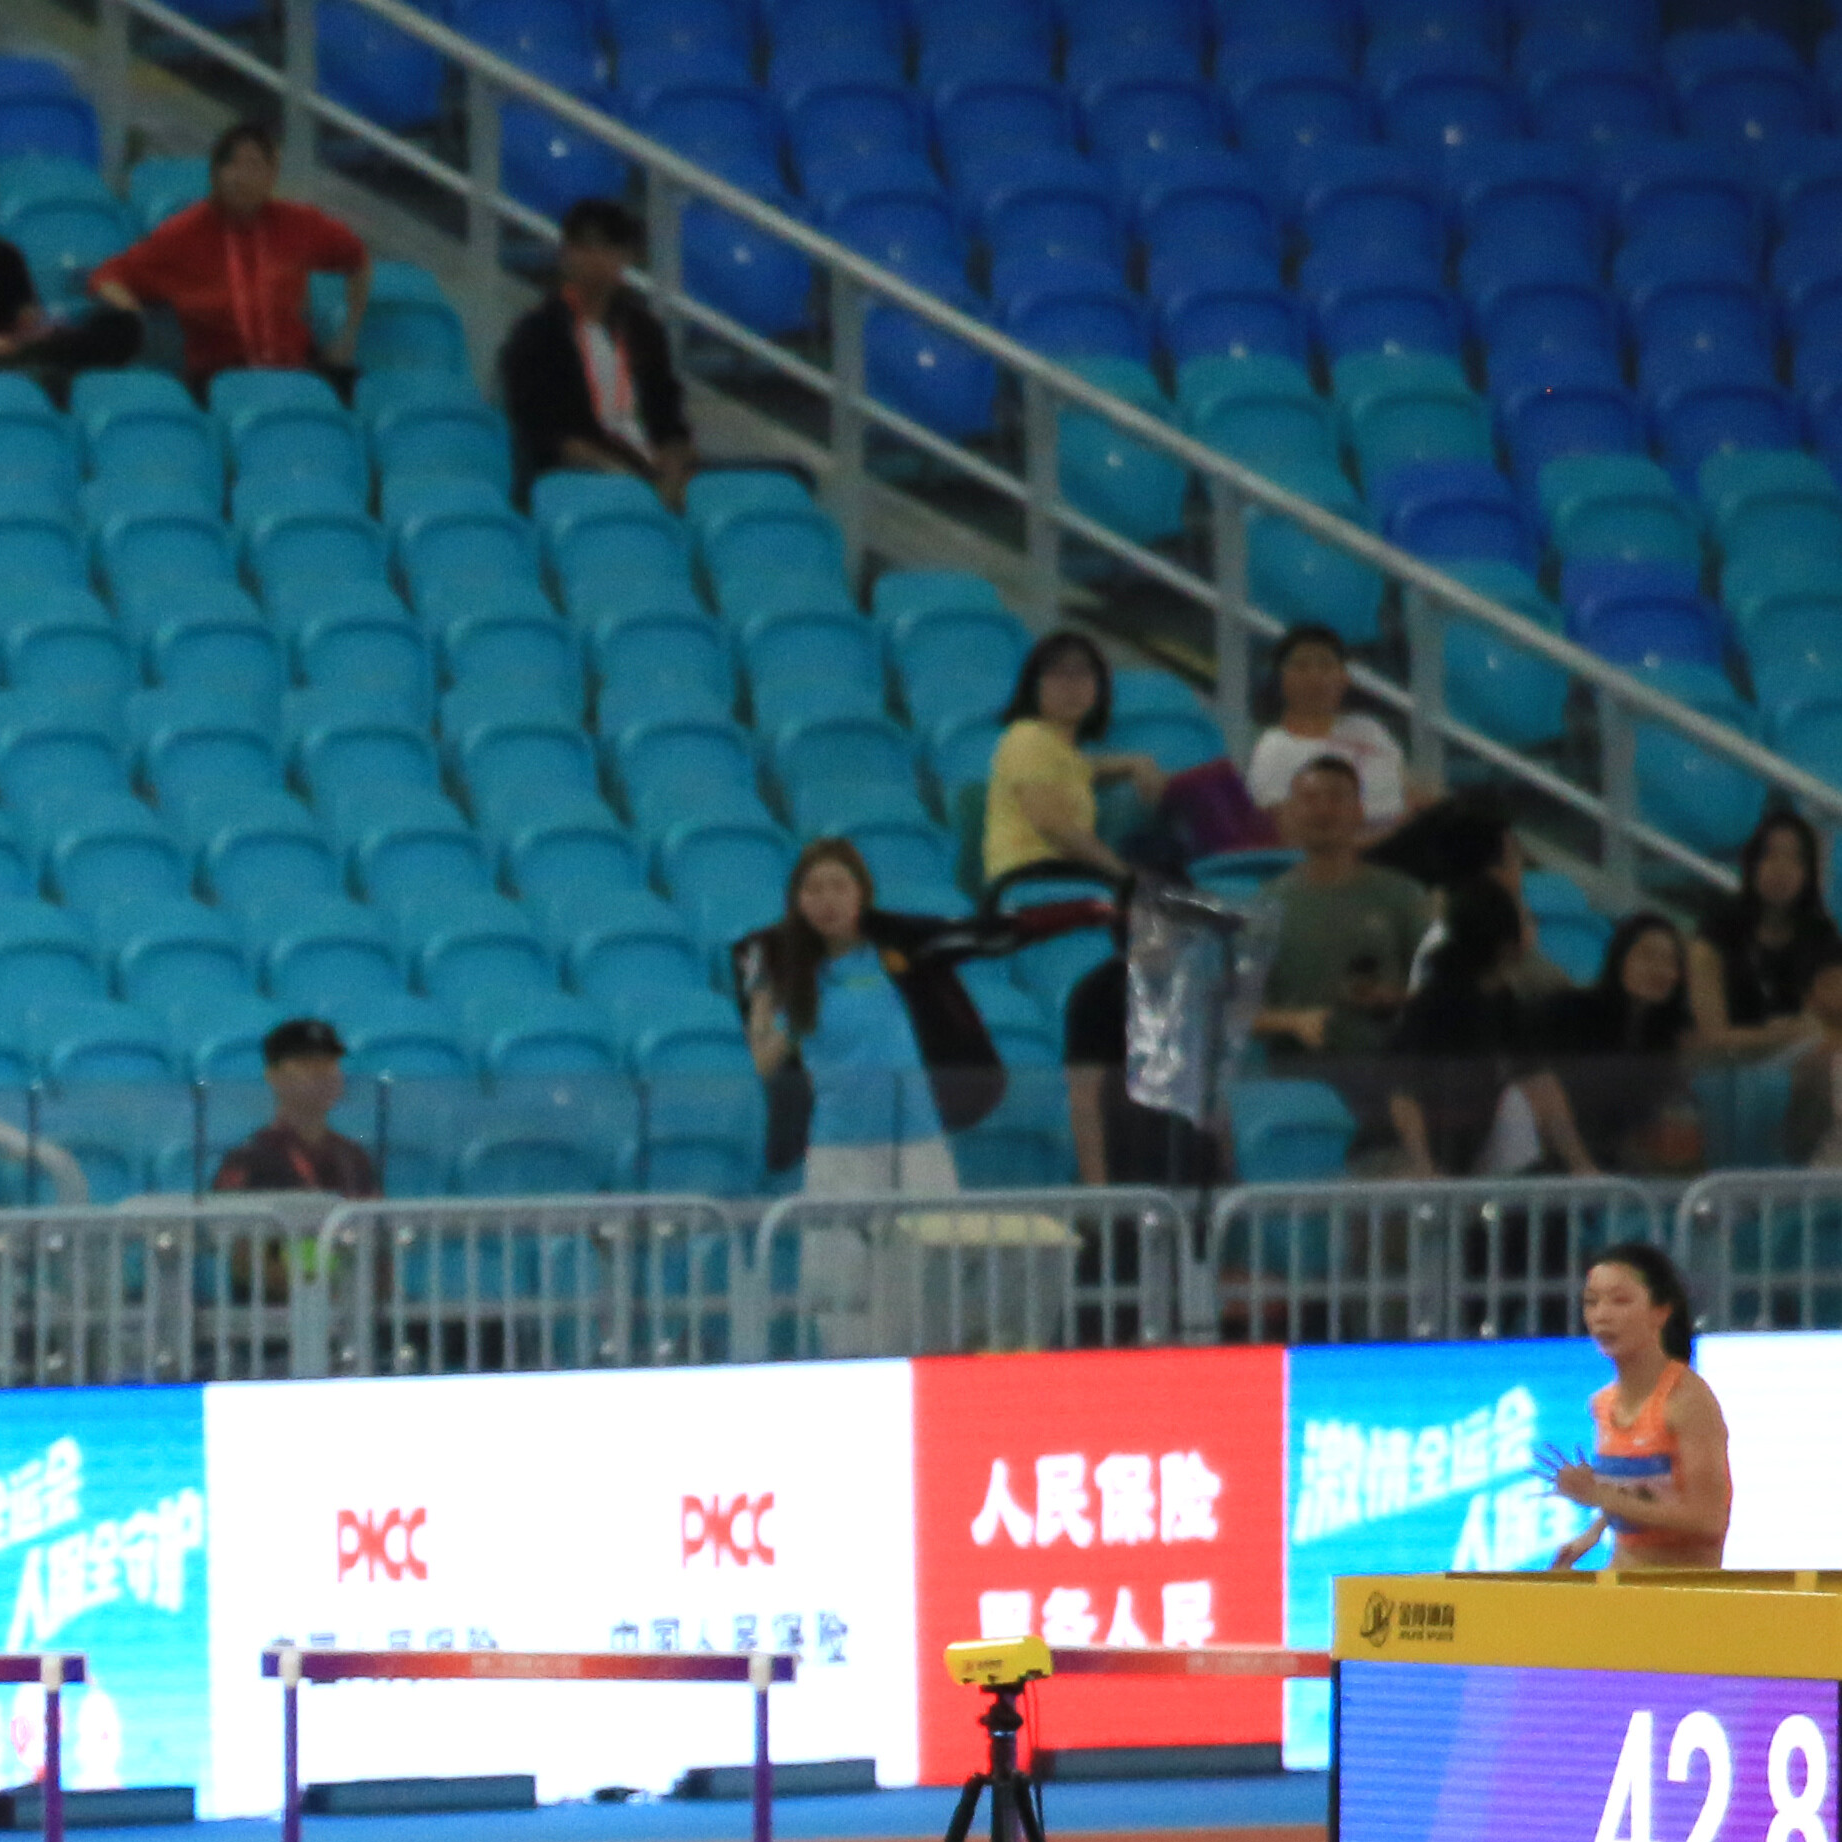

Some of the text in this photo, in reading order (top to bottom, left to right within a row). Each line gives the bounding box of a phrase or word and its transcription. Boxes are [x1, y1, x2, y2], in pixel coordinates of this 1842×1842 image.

[683, 1492, 775, 1567] PICC
[971, 1450, 1222, 1548] 人民保险
[337, 1507, 428, 1591] PICC
